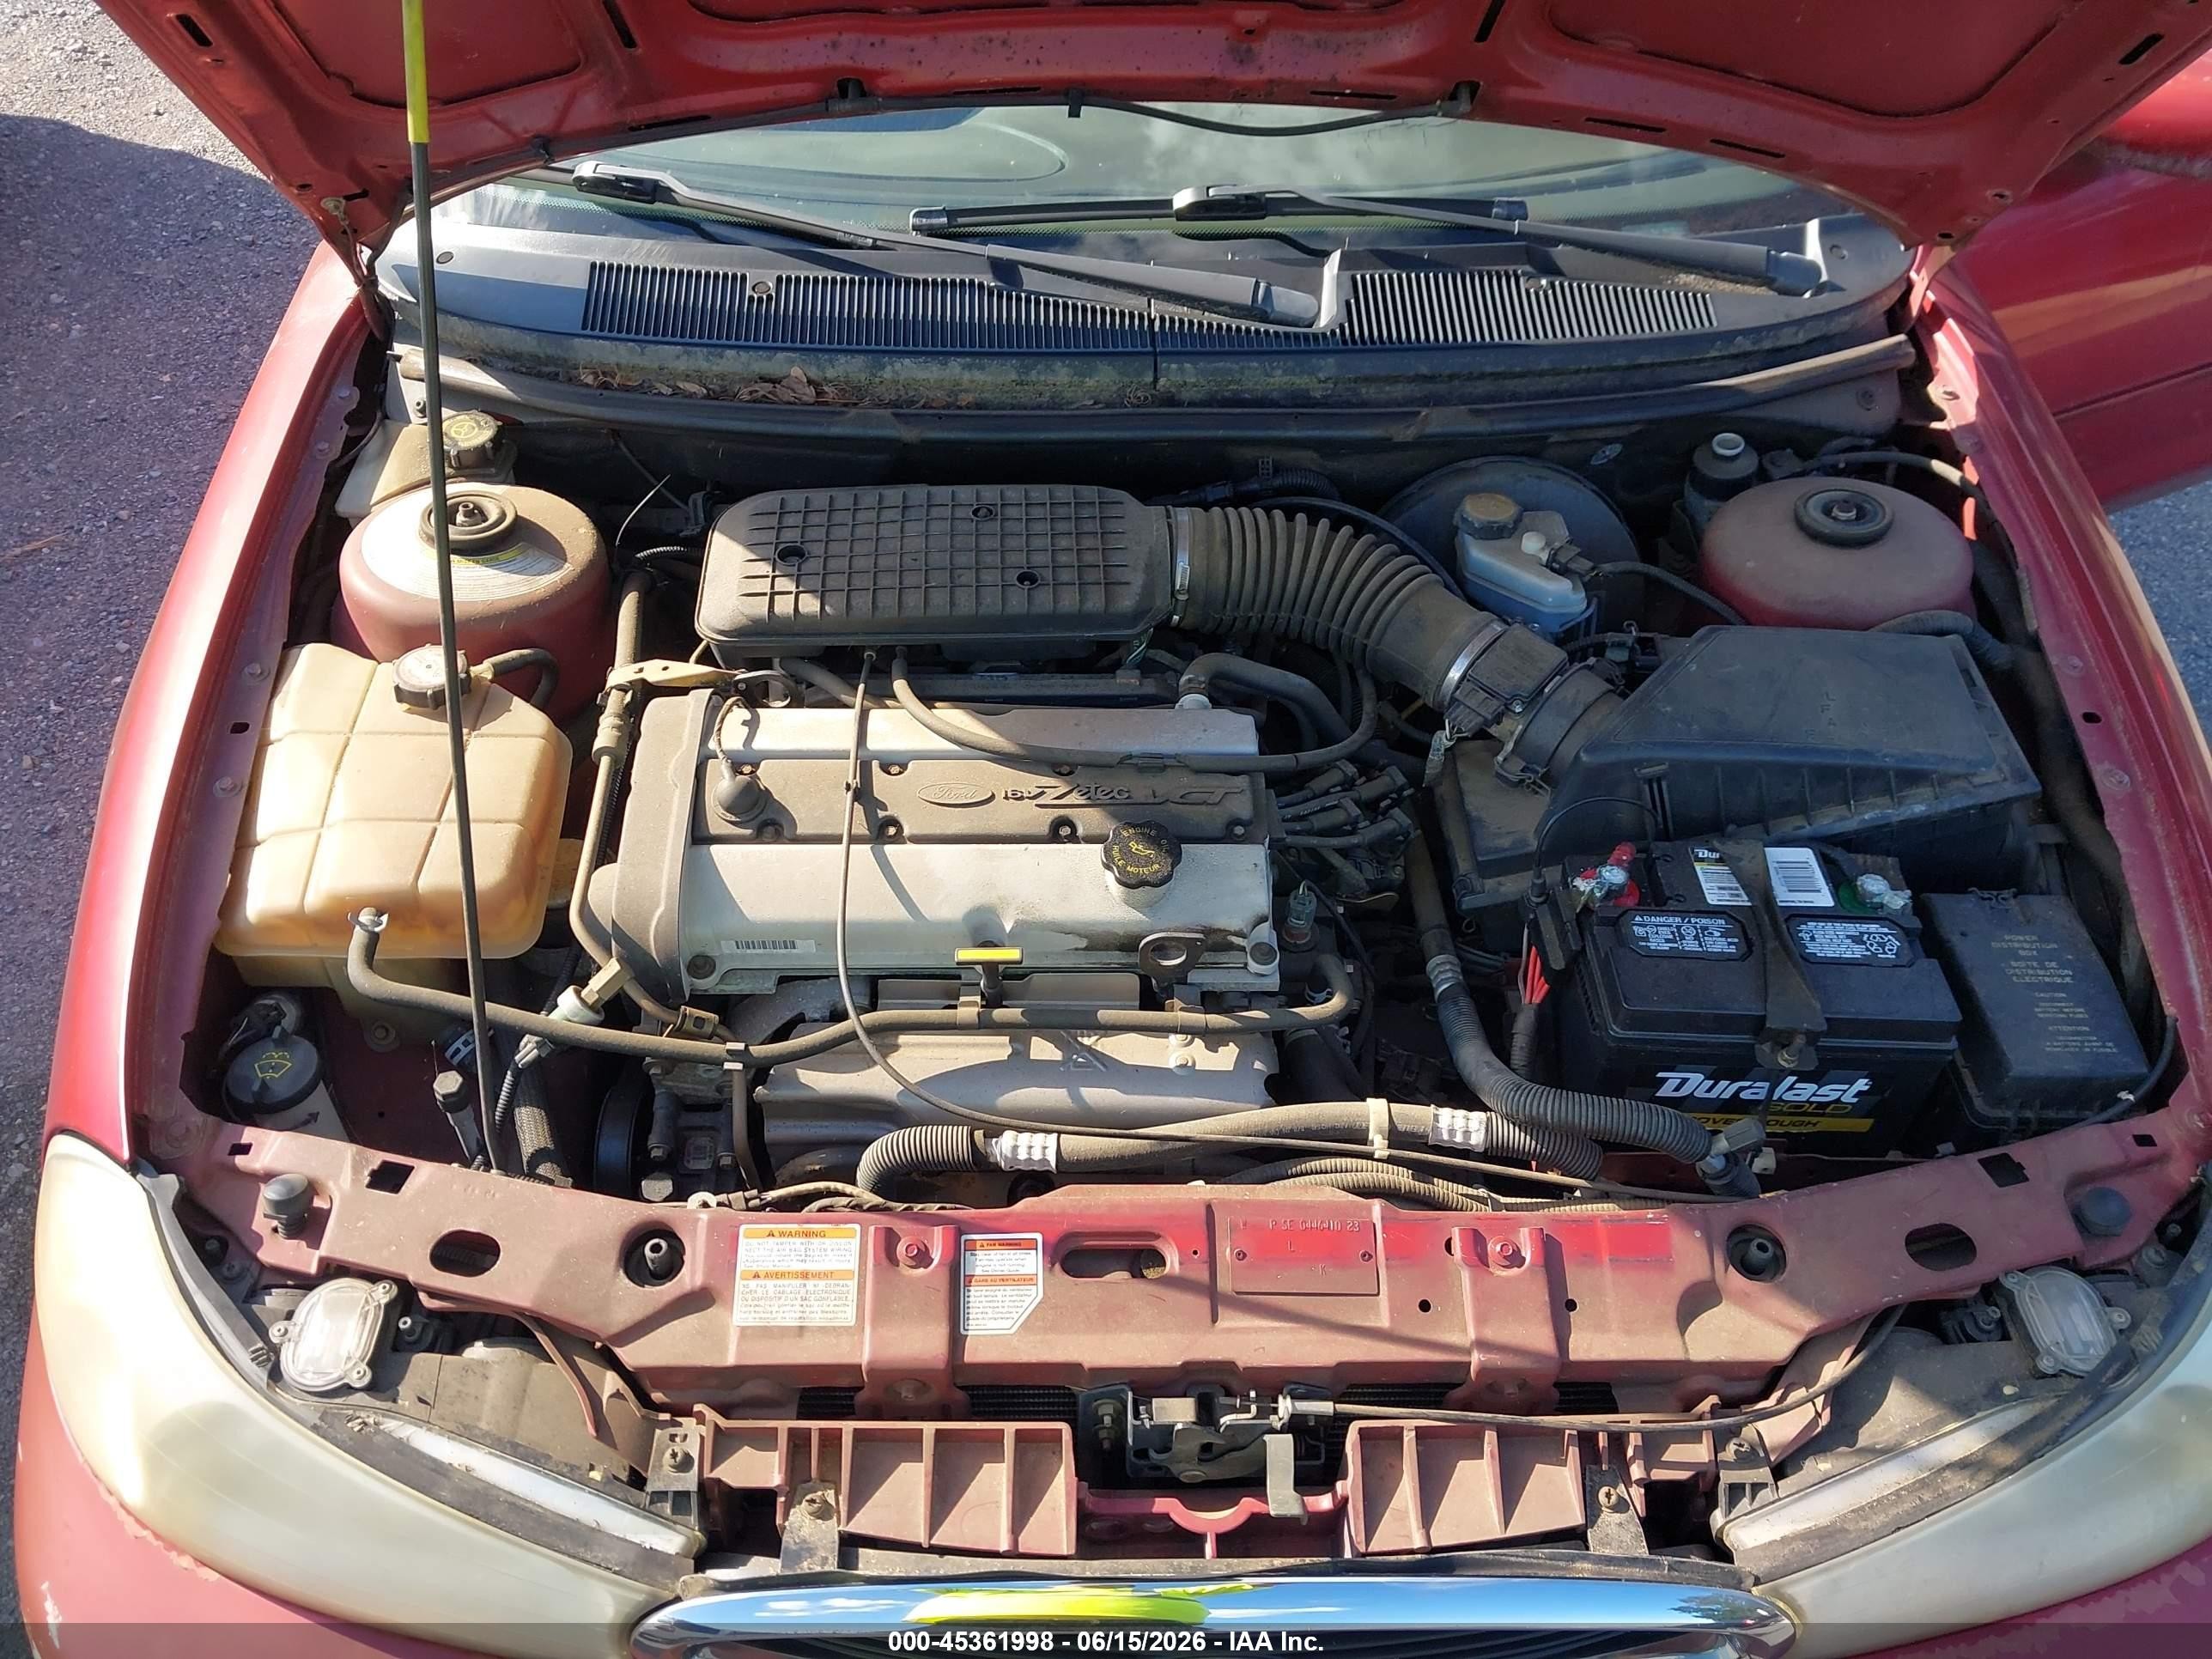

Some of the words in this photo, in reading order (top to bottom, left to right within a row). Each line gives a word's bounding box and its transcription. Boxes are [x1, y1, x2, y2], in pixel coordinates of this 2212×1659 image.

[1121, 826, 1158, 837] ENGINE
[1112, 845, 1127, 866] HUILE
[1127, 863, 1161, 874] MOTEUR
[1656, 1072, 1872, 1103] Duralast
[1346, 1219, 1360, 1231] 23
